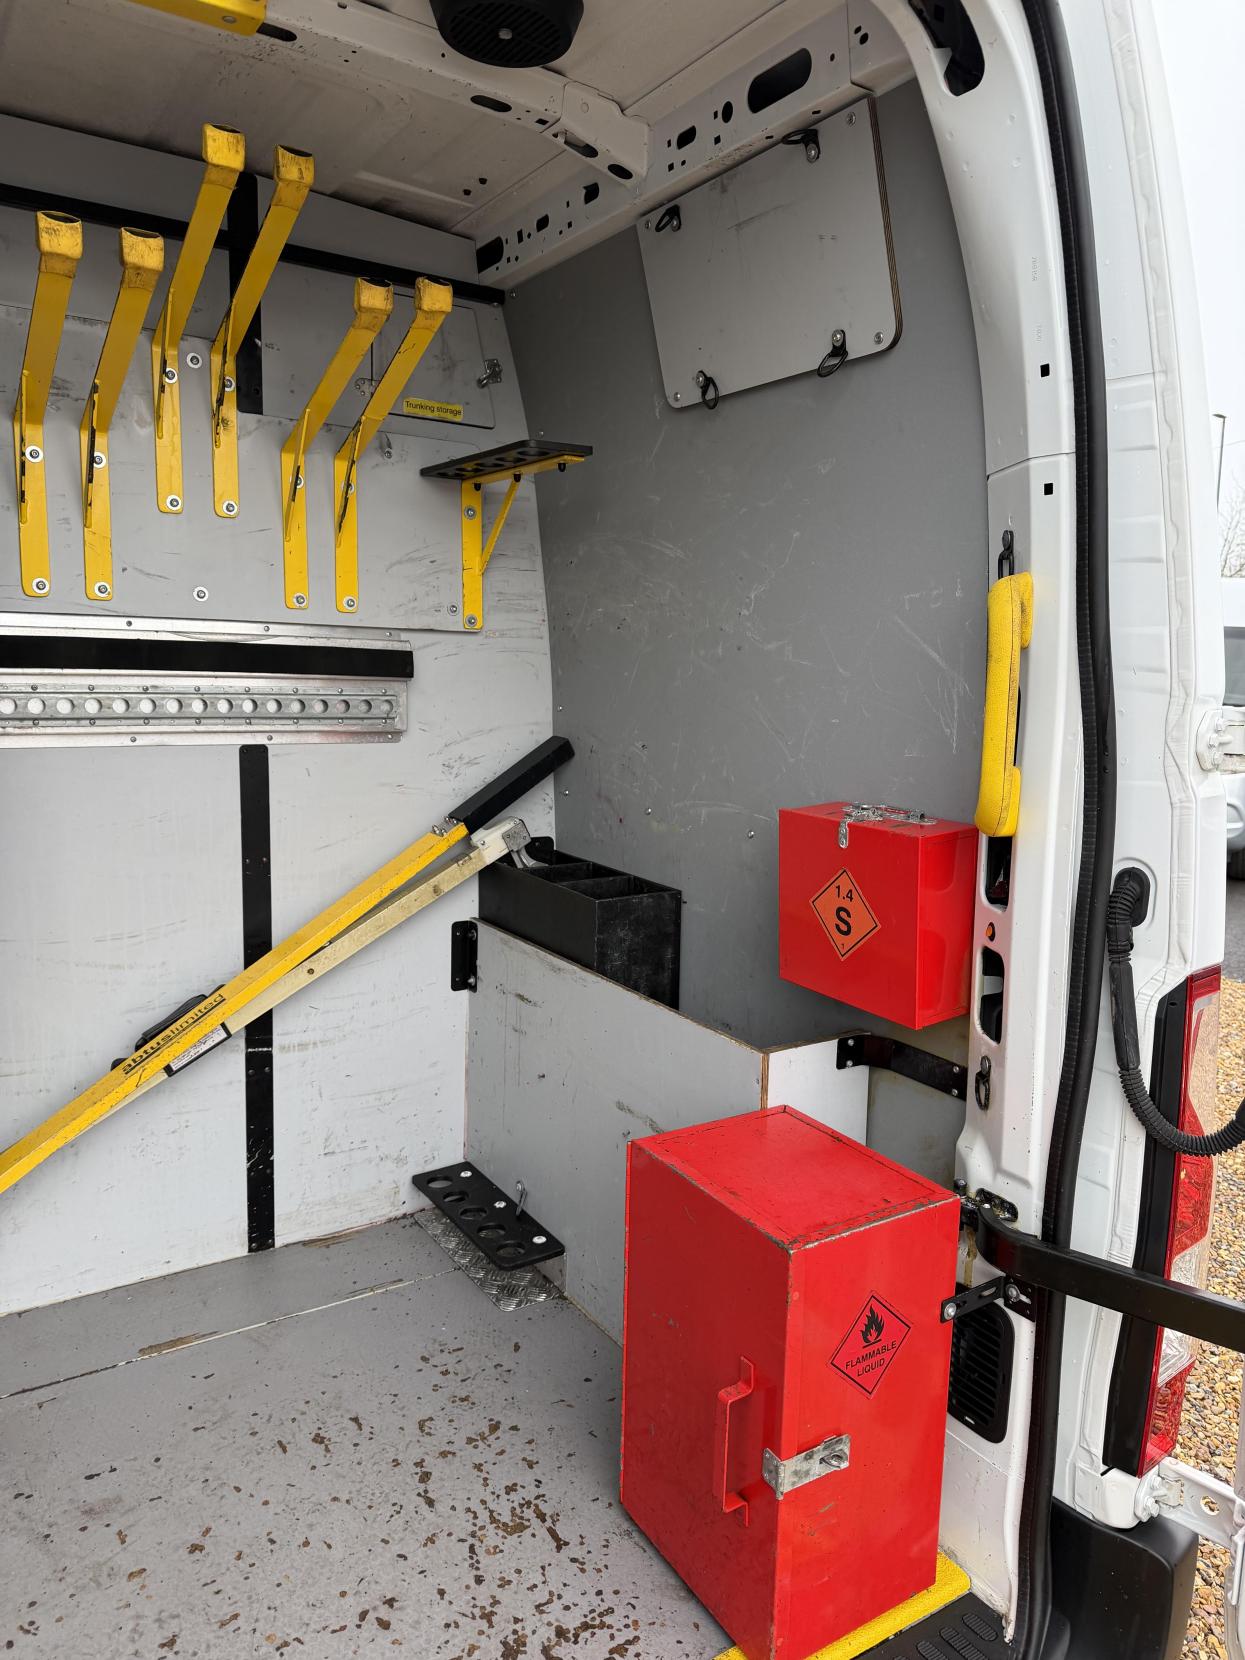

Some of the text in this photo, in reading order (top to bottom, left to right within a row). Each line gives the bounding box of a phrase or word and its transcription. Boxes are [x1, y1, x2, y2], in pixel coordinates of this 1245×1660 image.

[405, 400, 462, 417] Trunking storage
[835, 885, 854, 902] 1.4
[834, 906, 852, 936] S
[845, 1340, 897, 1370] FLAMMABLE
[856, 1358, 885, 1377] LIQUID
